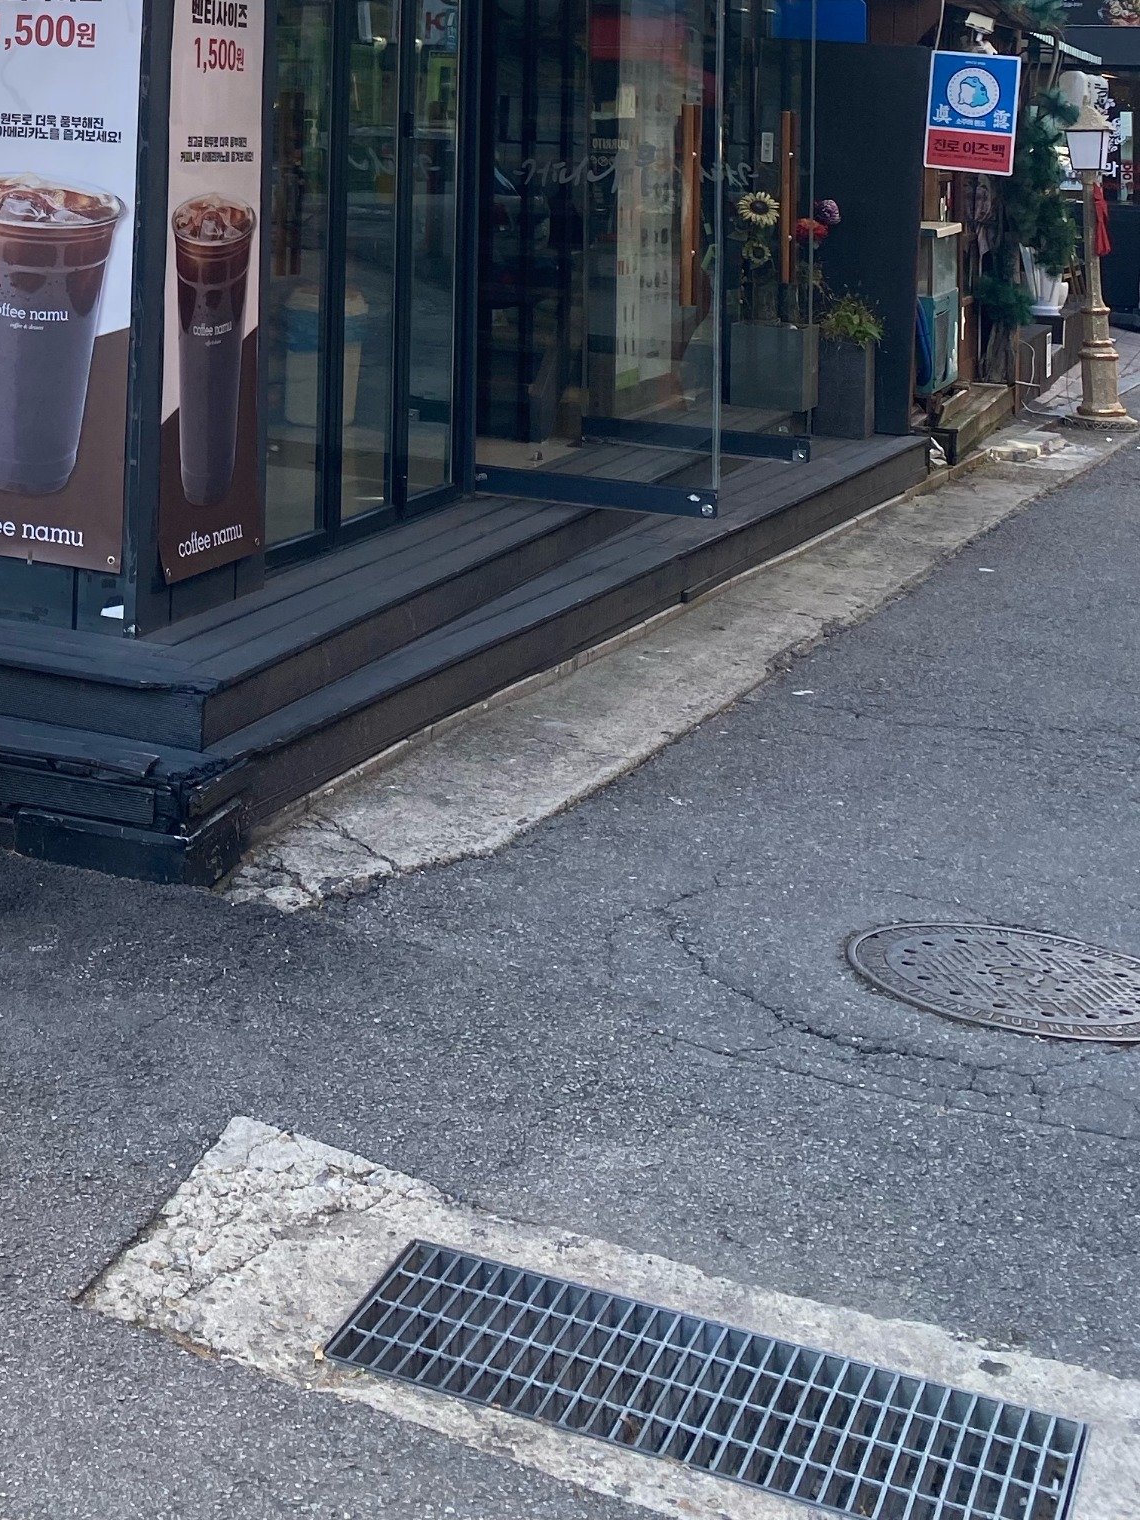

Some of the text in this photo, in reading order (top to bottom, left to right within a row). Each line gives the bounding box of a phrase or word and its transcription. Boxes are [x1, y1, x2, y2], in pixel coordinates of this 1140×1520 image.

[194, 37, 245, 74] 1,500원
[1, 112, 32, 125] 원두로
[36, 114, 56, 127] 더욱
[60, 115, 104, 129] 풍부해진
[63, 129, 121, 143] 즐겨보세요!
[933, 138, 960, 153] 진로
[963, 141, 989, 155] 이즈
[991, 144, 1005, 158] 백
[513, 155, 620, 193] 커피나
[29, 310, 68, 321] namu
[193, 321, 232, 336] coffee namu
[21, 519, 84, 547] namu
[178, 524, 243, 558] coffee namu
